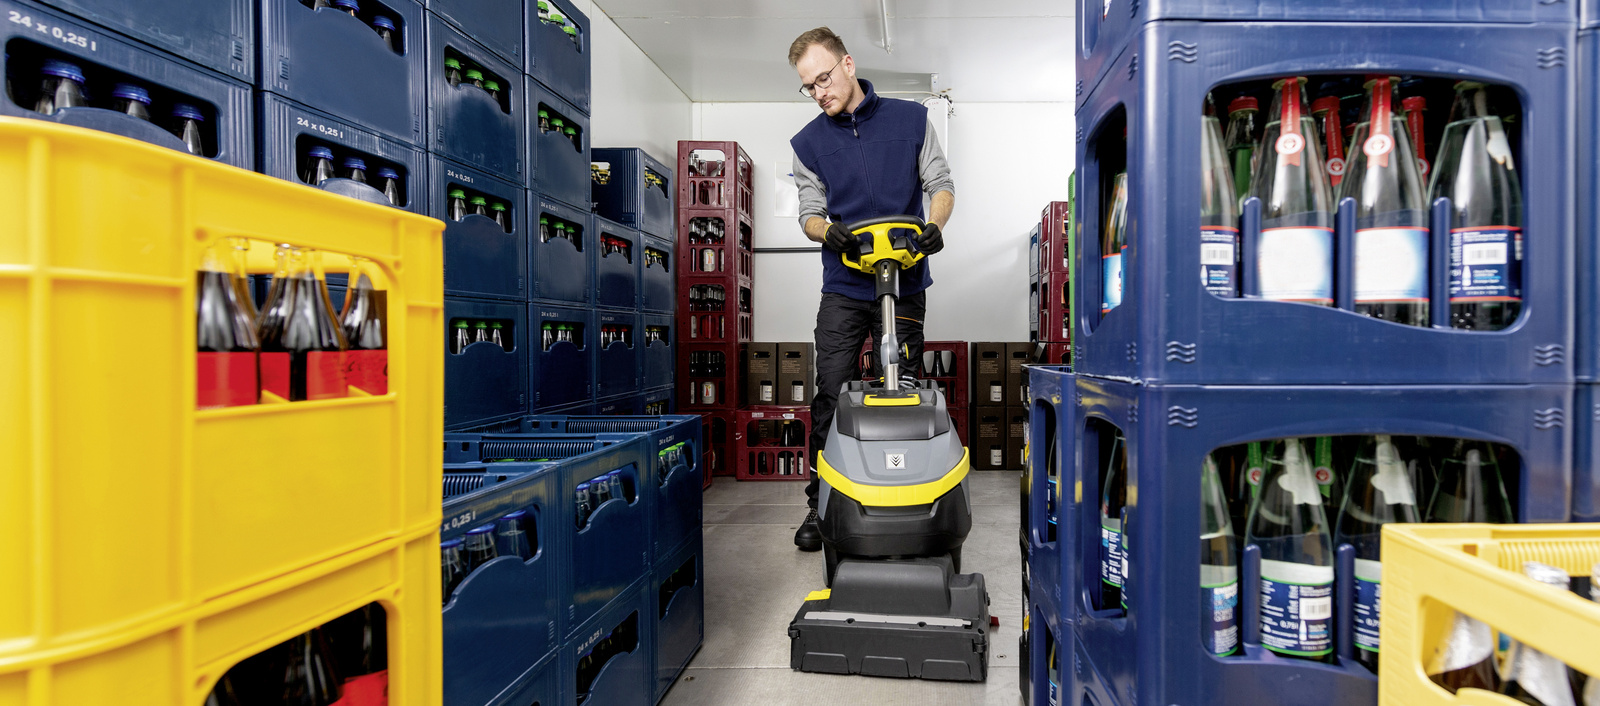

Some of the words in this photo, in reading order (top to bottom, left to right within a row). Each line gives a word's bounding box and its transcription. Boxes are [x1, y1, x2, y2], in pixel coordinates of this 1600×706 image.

[9, 11, 32, 27] 24
[36, 22, 47, 34] x
[52, 26, 87, 48] 0,25
[297, 117, 309, 127] 24
[311, 123, 317, 131] x
[319, 124, 338, 137] 0,25
[447, 169, 454, 177] 24
[459, 174, 471, 182] 0,25
[443, 522, 450, 532] x
[451, 512, 471, 528] 0,25
